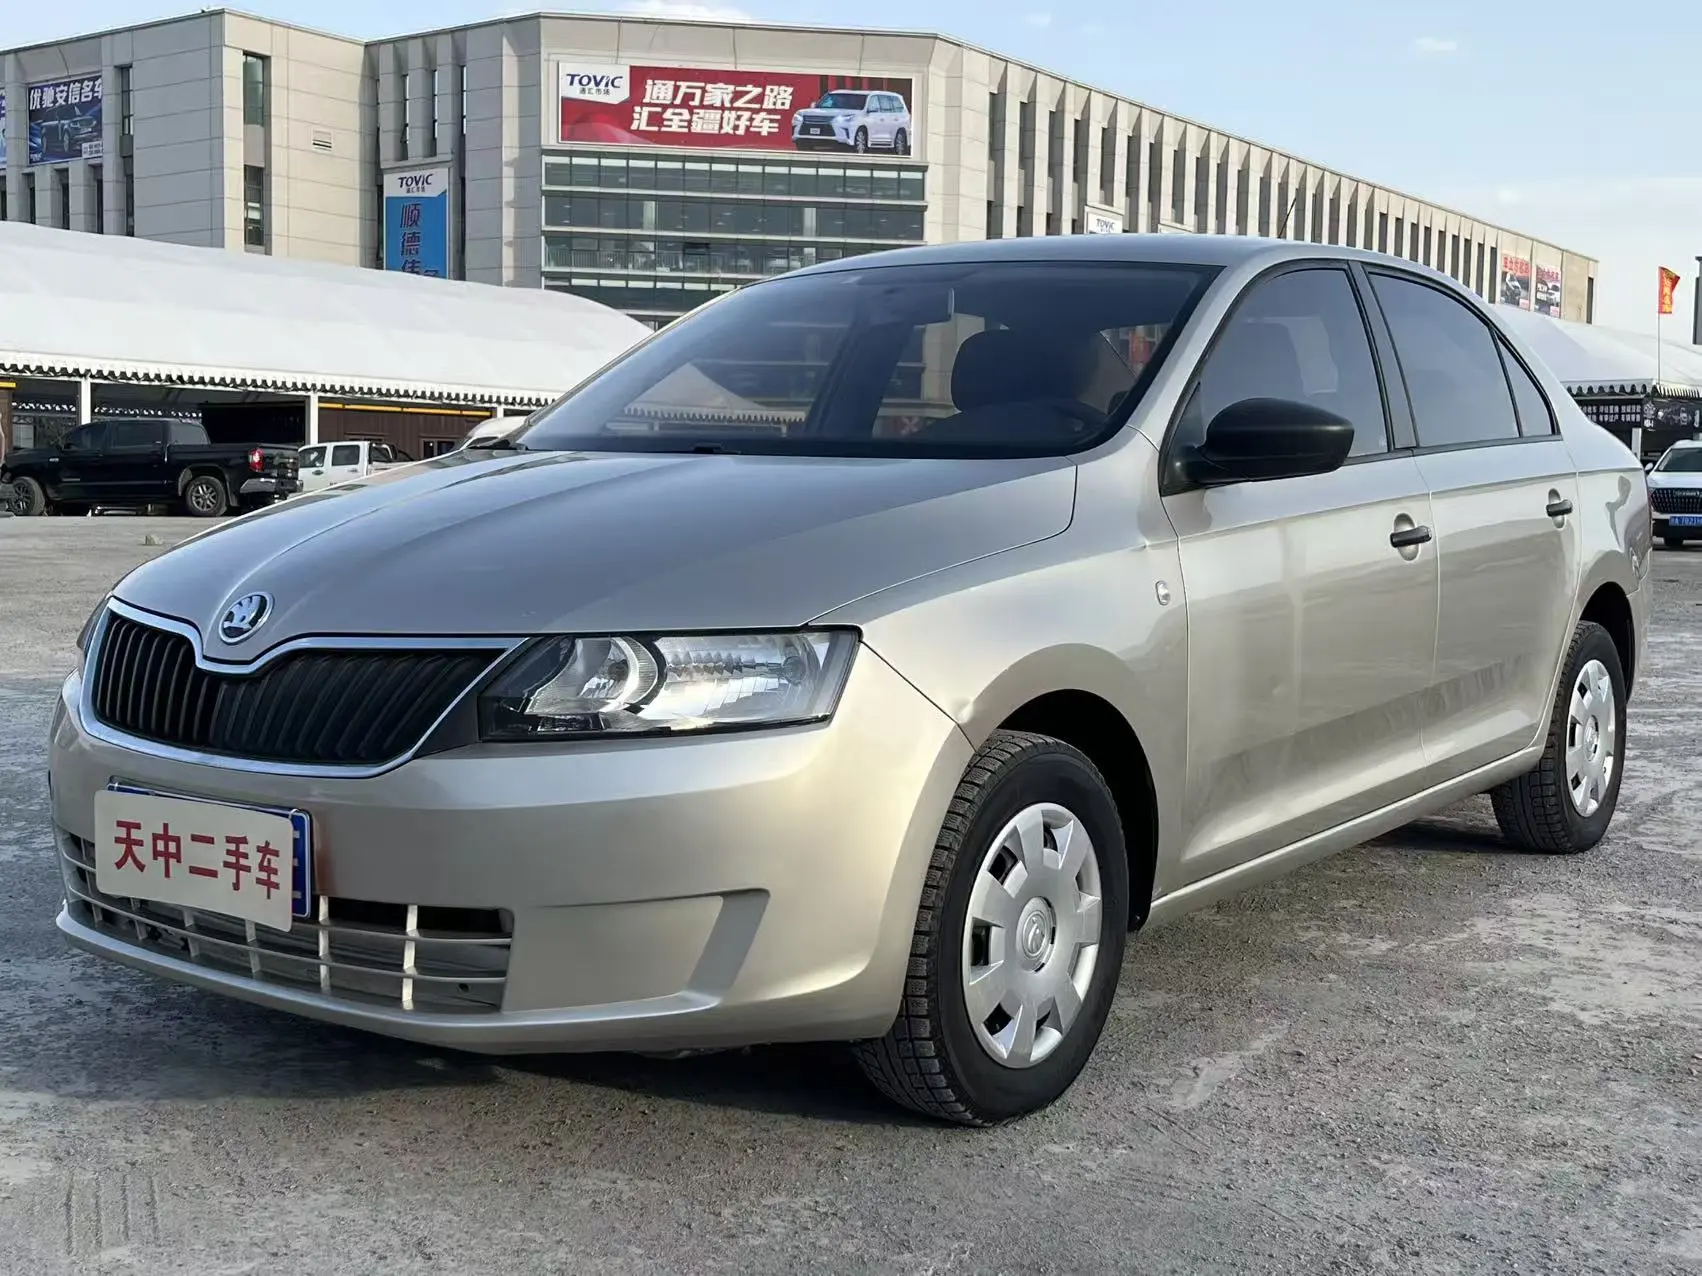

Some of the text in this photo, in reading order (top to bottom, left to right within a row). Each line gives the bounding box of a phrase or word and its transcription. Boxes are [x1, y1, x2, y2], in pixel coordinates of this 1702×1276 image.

[29, 78, 102, 109] 优驰安信名车
[566, 73, 623, 88] TOVIC
[642, 79, 793, 110] 通万家之路
[630, 106, 781, 137] 汇全疆好车
[398, 173, 434, 188] TOVIC
[114, 819, 281, 899] 天中二手车
